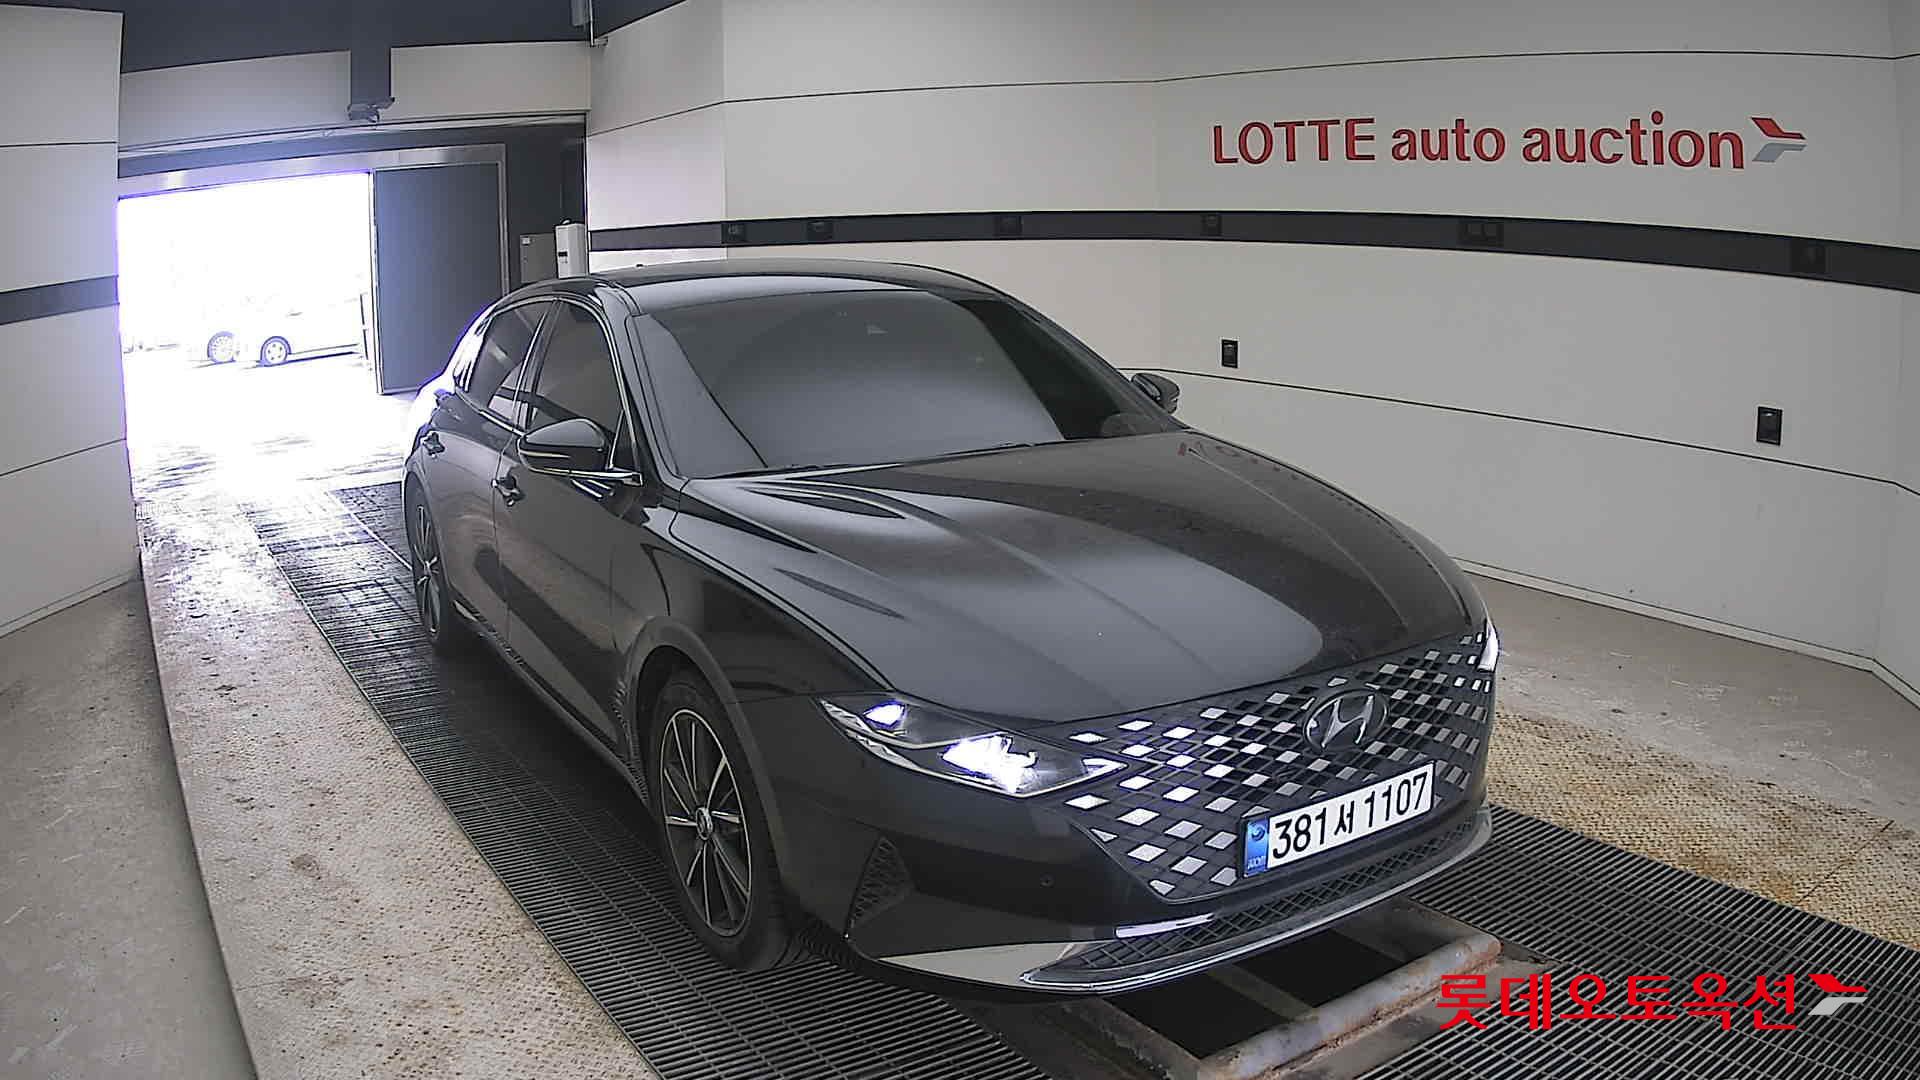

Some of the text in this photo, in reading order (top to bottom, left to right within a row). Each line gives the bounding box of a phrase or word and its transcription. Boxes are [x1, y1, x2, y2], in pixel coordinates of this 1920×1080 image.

[1213, 111, 1745, 169] LOTTE auto auction
[1364, 771, 1428, 828] 1107
